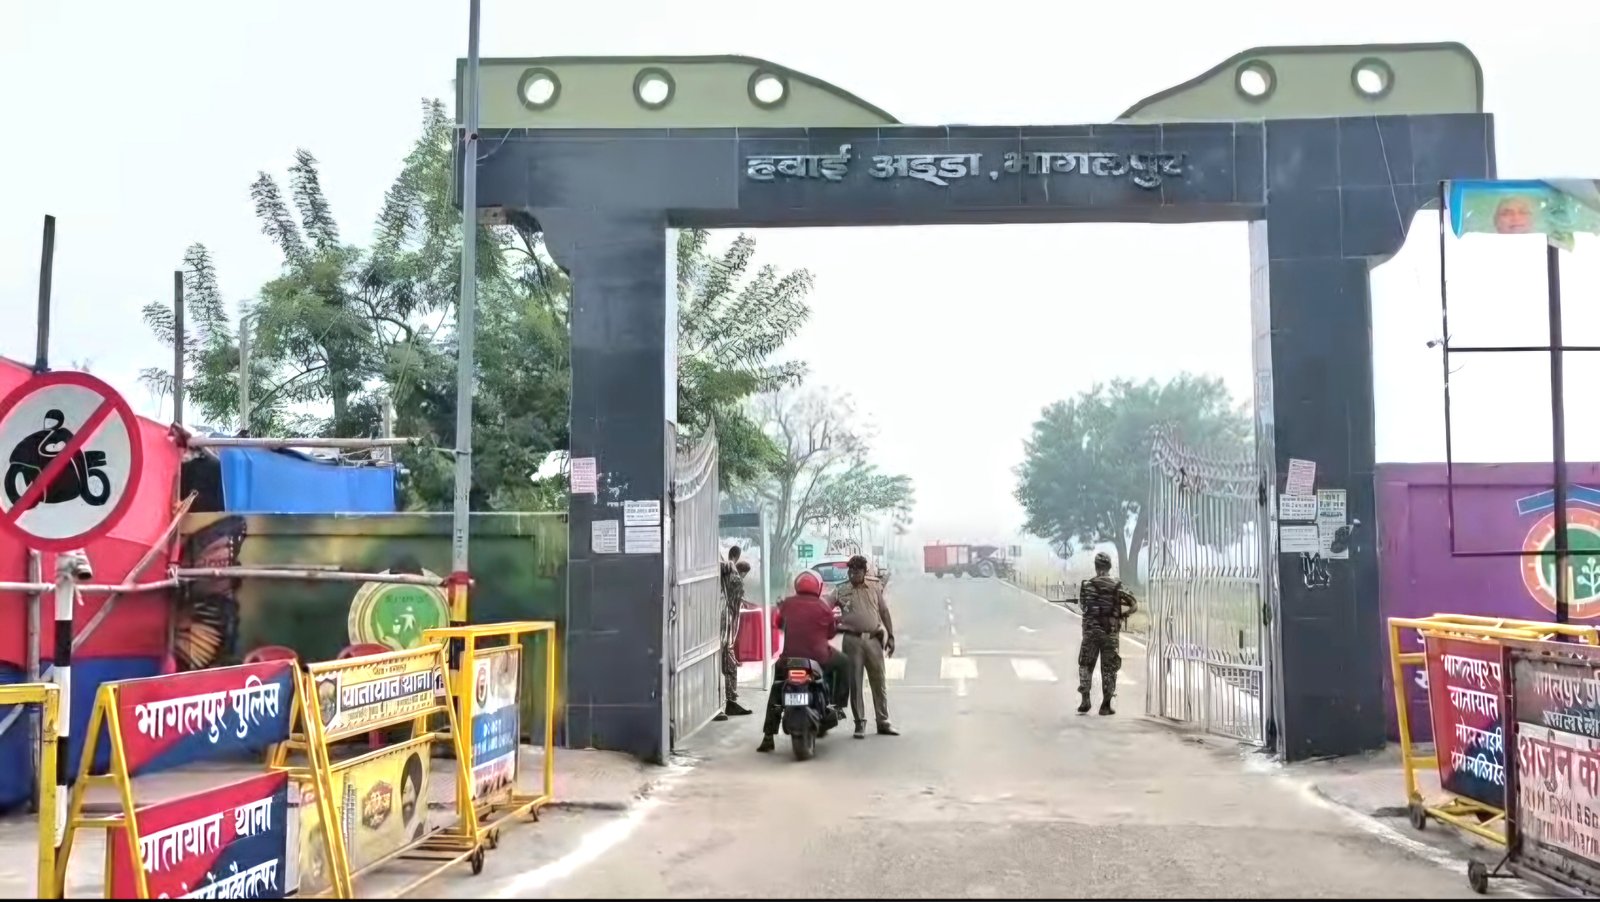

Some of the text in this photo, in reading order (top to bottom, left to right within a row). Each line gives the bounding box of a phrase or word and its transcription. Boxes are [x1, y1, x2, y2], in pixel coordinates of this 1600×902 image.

[745, 143, 851, 181] हवाई
[1003, 150, 1188, 189] भागलपुर
[135, 690, 228, 743] भागलपुर
[229, 675, 280, 738] पुलिस
[342, 676, 400, 708] यातायात
[400, 671, 432, 697] थाना
[1447, 685, 1499, 720] यातायात
[139, 796, 274, 873] यातायात थाना
